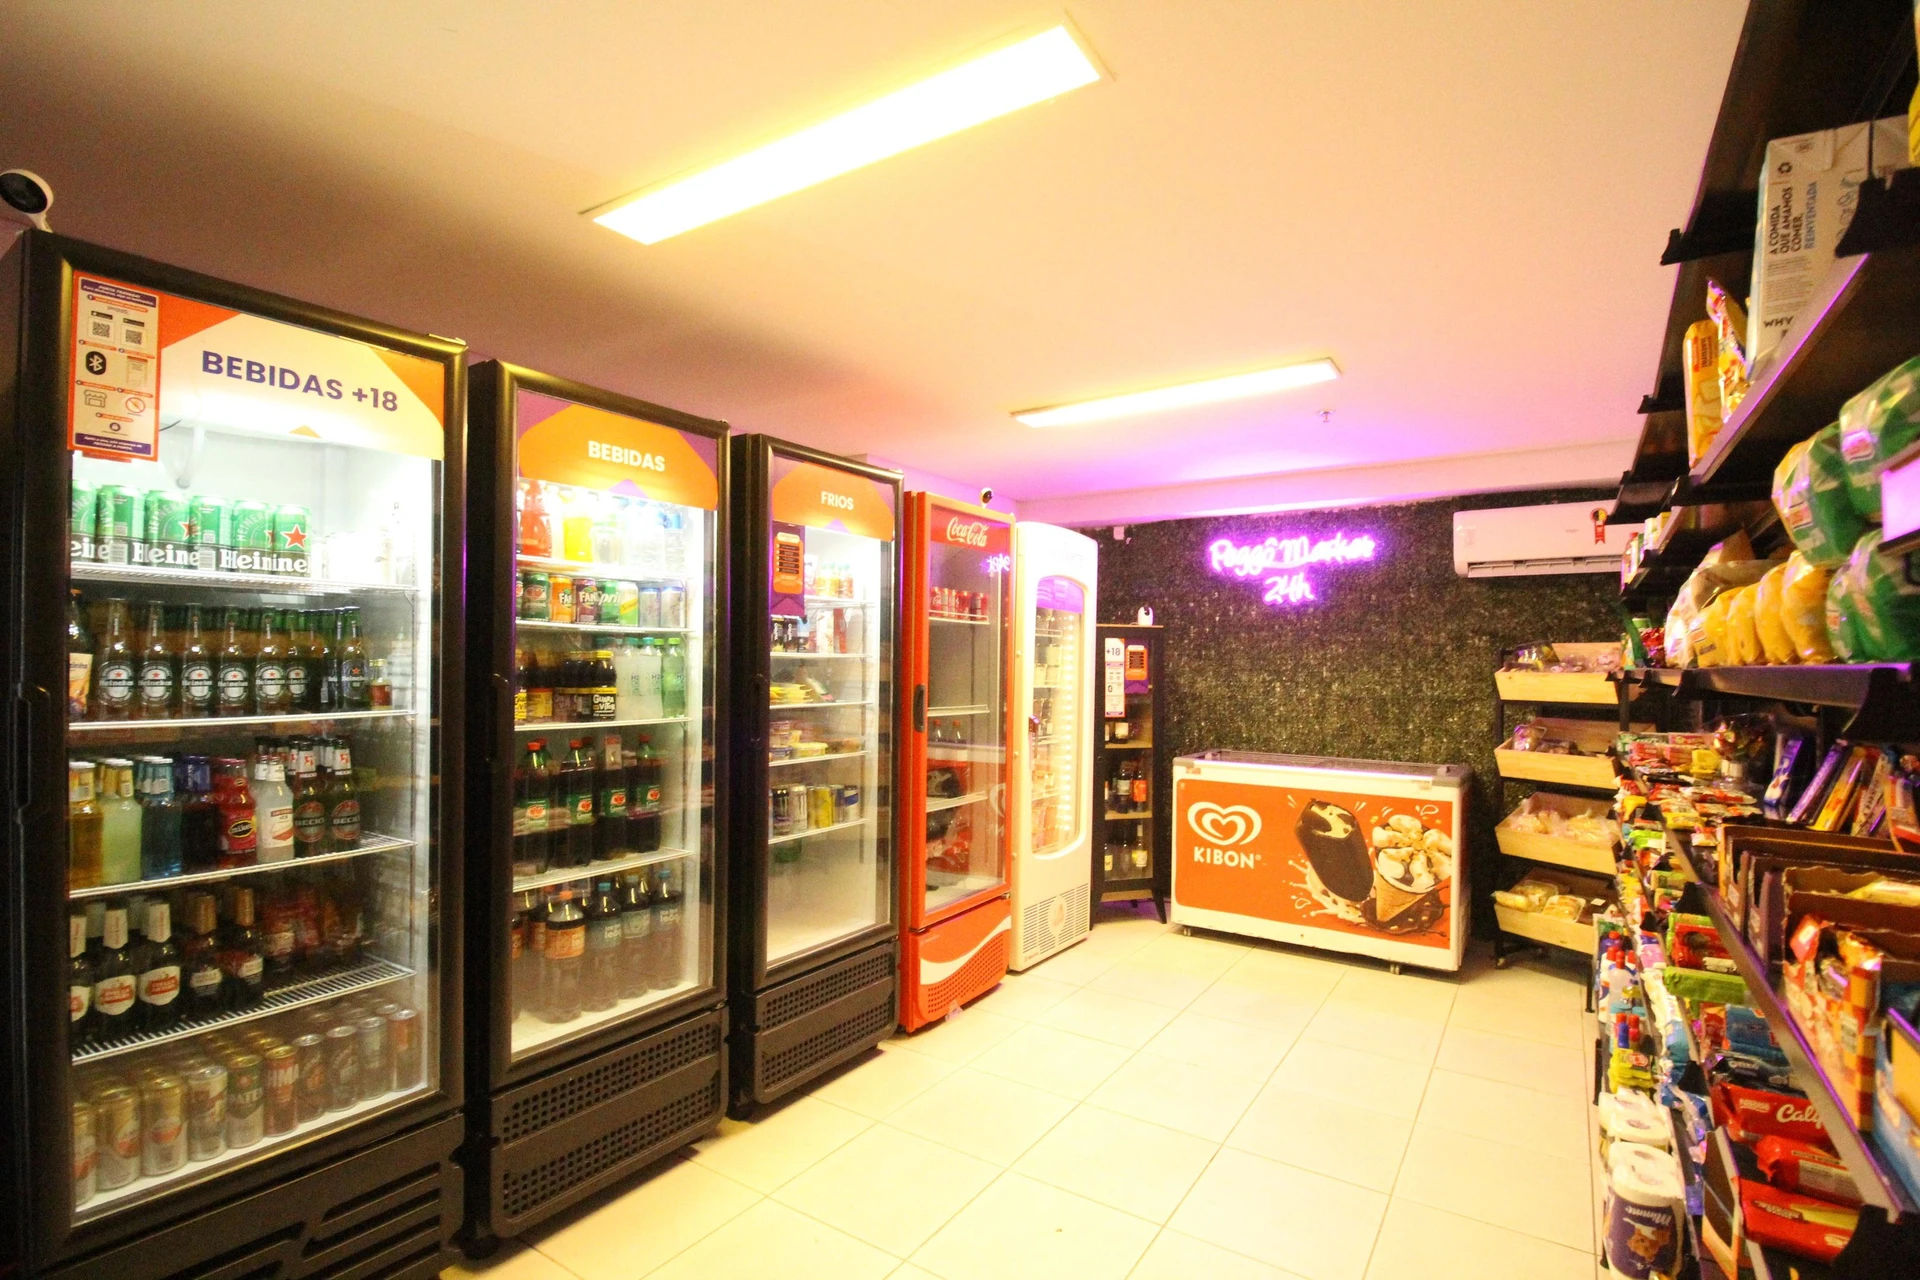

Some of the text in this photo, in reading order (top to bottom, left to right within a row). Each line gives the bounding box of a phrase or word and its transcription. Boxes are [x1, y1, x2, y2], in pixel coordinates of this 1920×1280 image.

[1769, 205, 1780, 247] COMIDA
[1780, 186, 1793, 254] QUE AMAMOS
[1791, 213, 1803, 252] COMER
[1764, 315, 1794, 328] WHY
[202, 350, 399, 412] BEBIDAS +18
[587, 440, 665, 472] BEBIDAS
[820, 490, 854, 511] FRIOS
[1264, 572, 1315, 604] 24h
[1106, 647, 1121, 656] +18
[1194, 845, 1254, 870] KIBON
